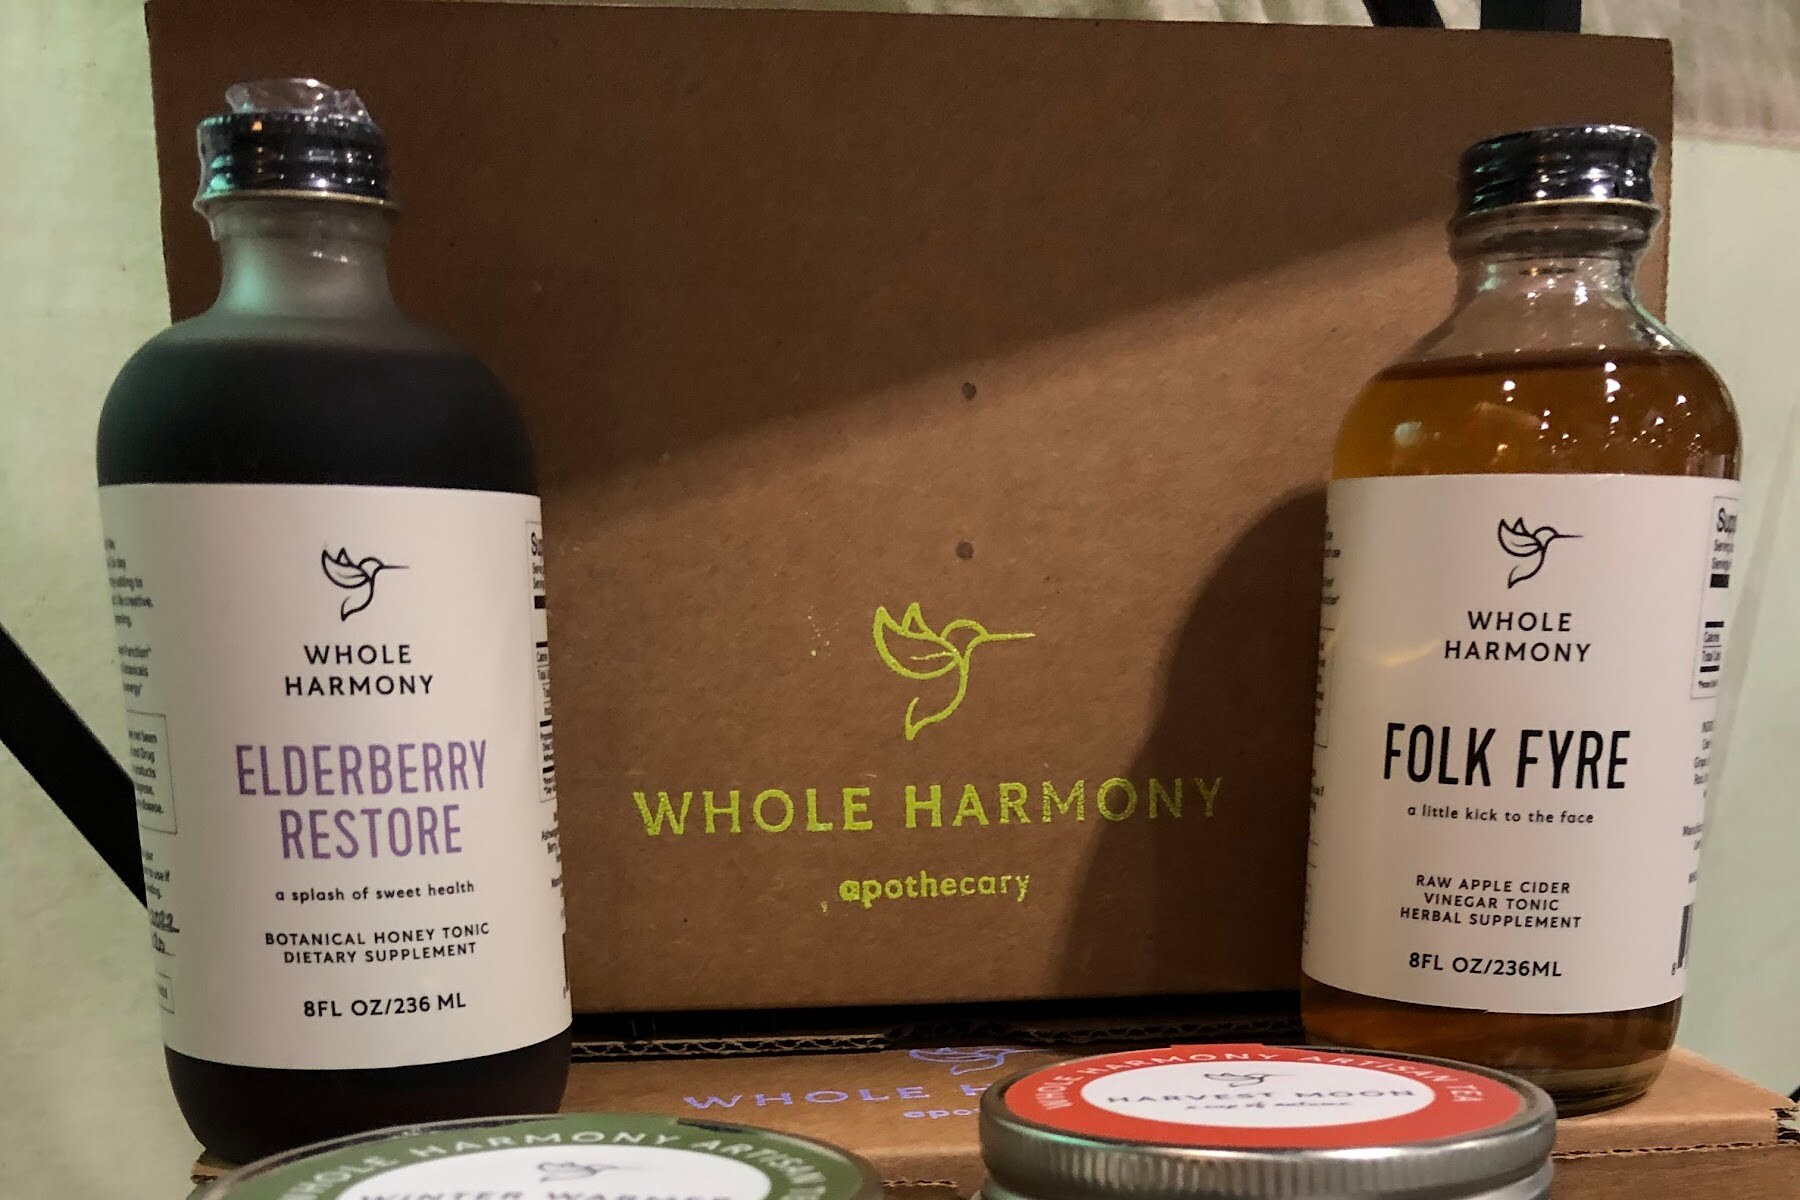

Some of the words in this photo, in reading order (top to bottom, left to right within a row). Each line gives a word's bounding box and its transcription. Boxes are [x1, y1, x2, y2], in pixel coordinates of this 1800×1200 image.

[1466, 610, 1572, 632] WHOLE
[303, 644, 412, 665] WHOLE
[1444, 640, 1591, 662] HARMONY
[285, 674, 434, 696] HARMONY
[1383, 722, 1497, 787] FOLK
[1516, 729, 1631, 789] FYRE
[235, 739, 488, 797] ELDERBERRY
[632, 786, 875, 836] WHOLE
[904, 776, 1224, 828] HARMONY
[1407, 805, 1416, 816] a
[1421, 803, 1459, 820] little
[1465, 807, 1498, 822] kick
[1504, 811, 1521, 823] to
[1528, 809, 1554, 824] the
[1560, 810, 1594, 824] face
[280, 803, 464, 860] RESTORE
[275, 891, 285, 901] a
[291, 887, 345, 904] splash
[352, 886, 369, 900] of
[376, 886, 422, 900] sweet
[428, 880, 475, 897] health
[838, 871, 1030, 909] apothecary
[1416, 874, 1453, 889] RAW
[1458, 879, 1513, 893] APPLE
[1520, 880, 1571, 894] CIDER
[1424, 892, 1498, 909] VINEGAR
[1506, 897, 1560, 911] TONIC
[1400, 907, 1462, 924] HERBAL
[1469, 913, 1582, 929] SUPPLEMENT
[265, 931, 366, 946] BOTANICAL
[374, 928, 435, 944] HONEY
[442, 922, 490, 939] TONIC
[284, 950, 357, 964] DIETARY
[365, 942, 477, 963] SUPPLEMENT
[1408, 951, 1444, 971] 8FL
[1452, 956, 1562, 977] OZ/236ML
[304, 1000, 343, 1018] 8FL
[351, 995, 431, 1017] OZ/236
[437, 992, 467, 1011] ML
[1077, 1052, 1281, 1075] HARMONY
[1298, 1054, 1459, 1082] ARTISAN
[682, 1085, 931, 1110] WHOLE
[1107, 1090, 1274, 1104] HARVEST
[1294, 1089, 1415, 1099] MOON
[408, 1130, 681, 1158] HARMONY
